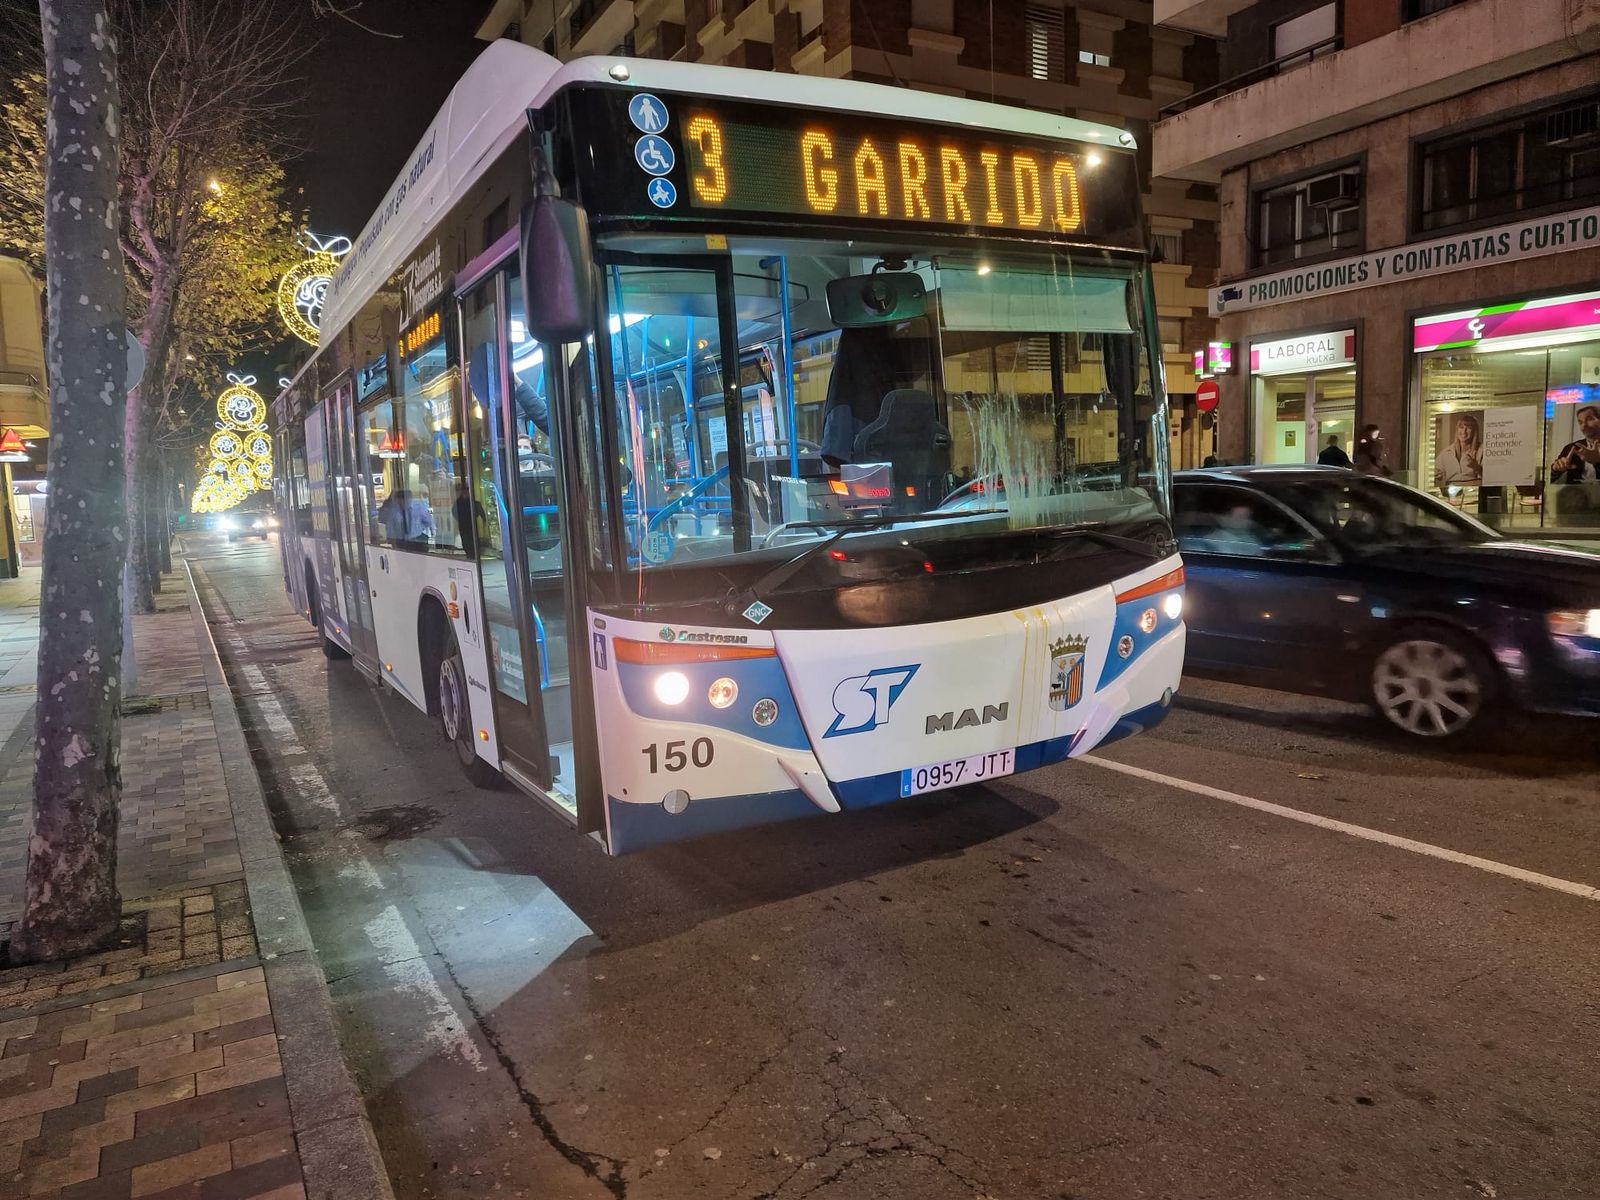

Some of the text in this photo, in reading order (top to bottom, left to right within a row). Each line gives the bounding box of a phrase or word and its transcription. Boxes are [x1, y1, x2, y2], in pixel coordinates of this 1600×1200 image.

[395, 178, 407, 216] gas
[408, 129, 437, 191] natural
[689, 117, 1082, 231] 3 GARRIDO
[1248, 214, 1598, 303] PROMOCIONES Y CONTRATAS CURTO
[1268, 338, 1336, 360] LABORAL
[1306, 353, 1336, 365] kutxa
[748, 608, 767, 619] GNC
[678, 630, 748, 644] Castrosua
[822, 663, 922, 738] ST
[925, 701, 1009, 735] MAN
[641, 736, 715, 775] 150
[916, 760, 966, 790] 0957
[975, 751, 1010, 778] JTT
